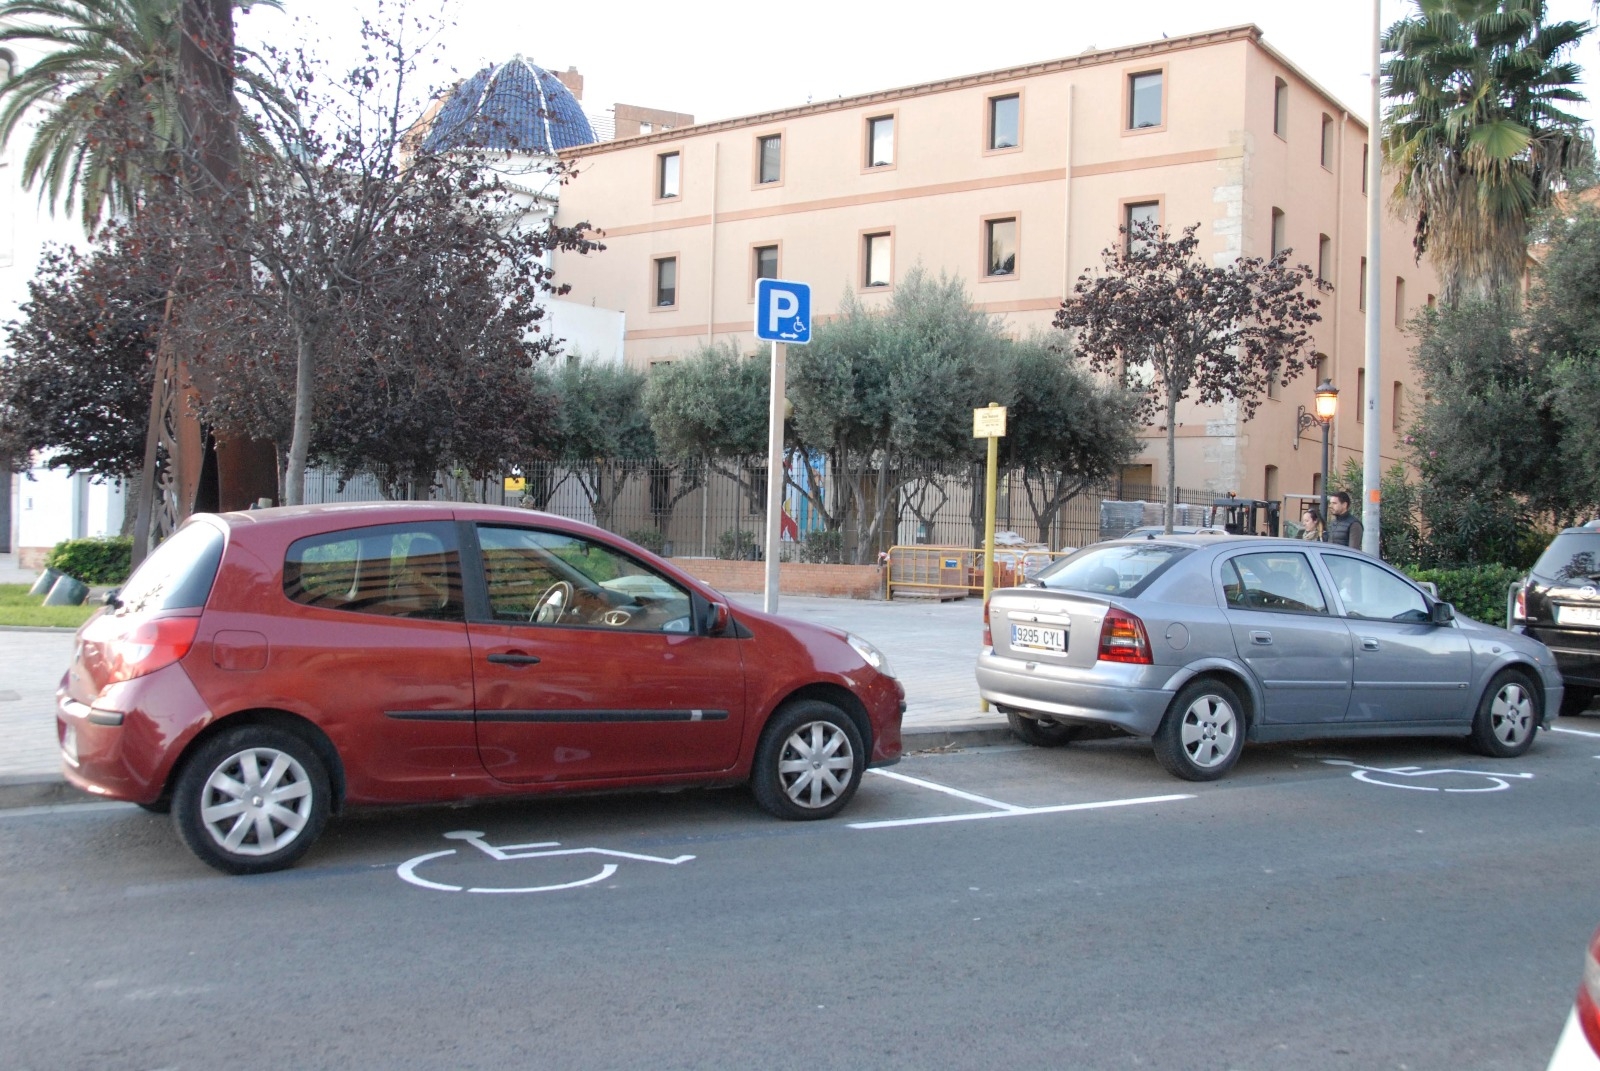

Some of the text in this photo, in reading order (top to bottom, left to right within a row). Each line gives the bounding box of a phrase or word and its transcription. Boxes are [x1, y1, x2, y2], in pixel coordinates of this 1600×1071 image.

[769, 289, 799, 332] P
[1017, 627, 1062, 647] 9295 CYL
